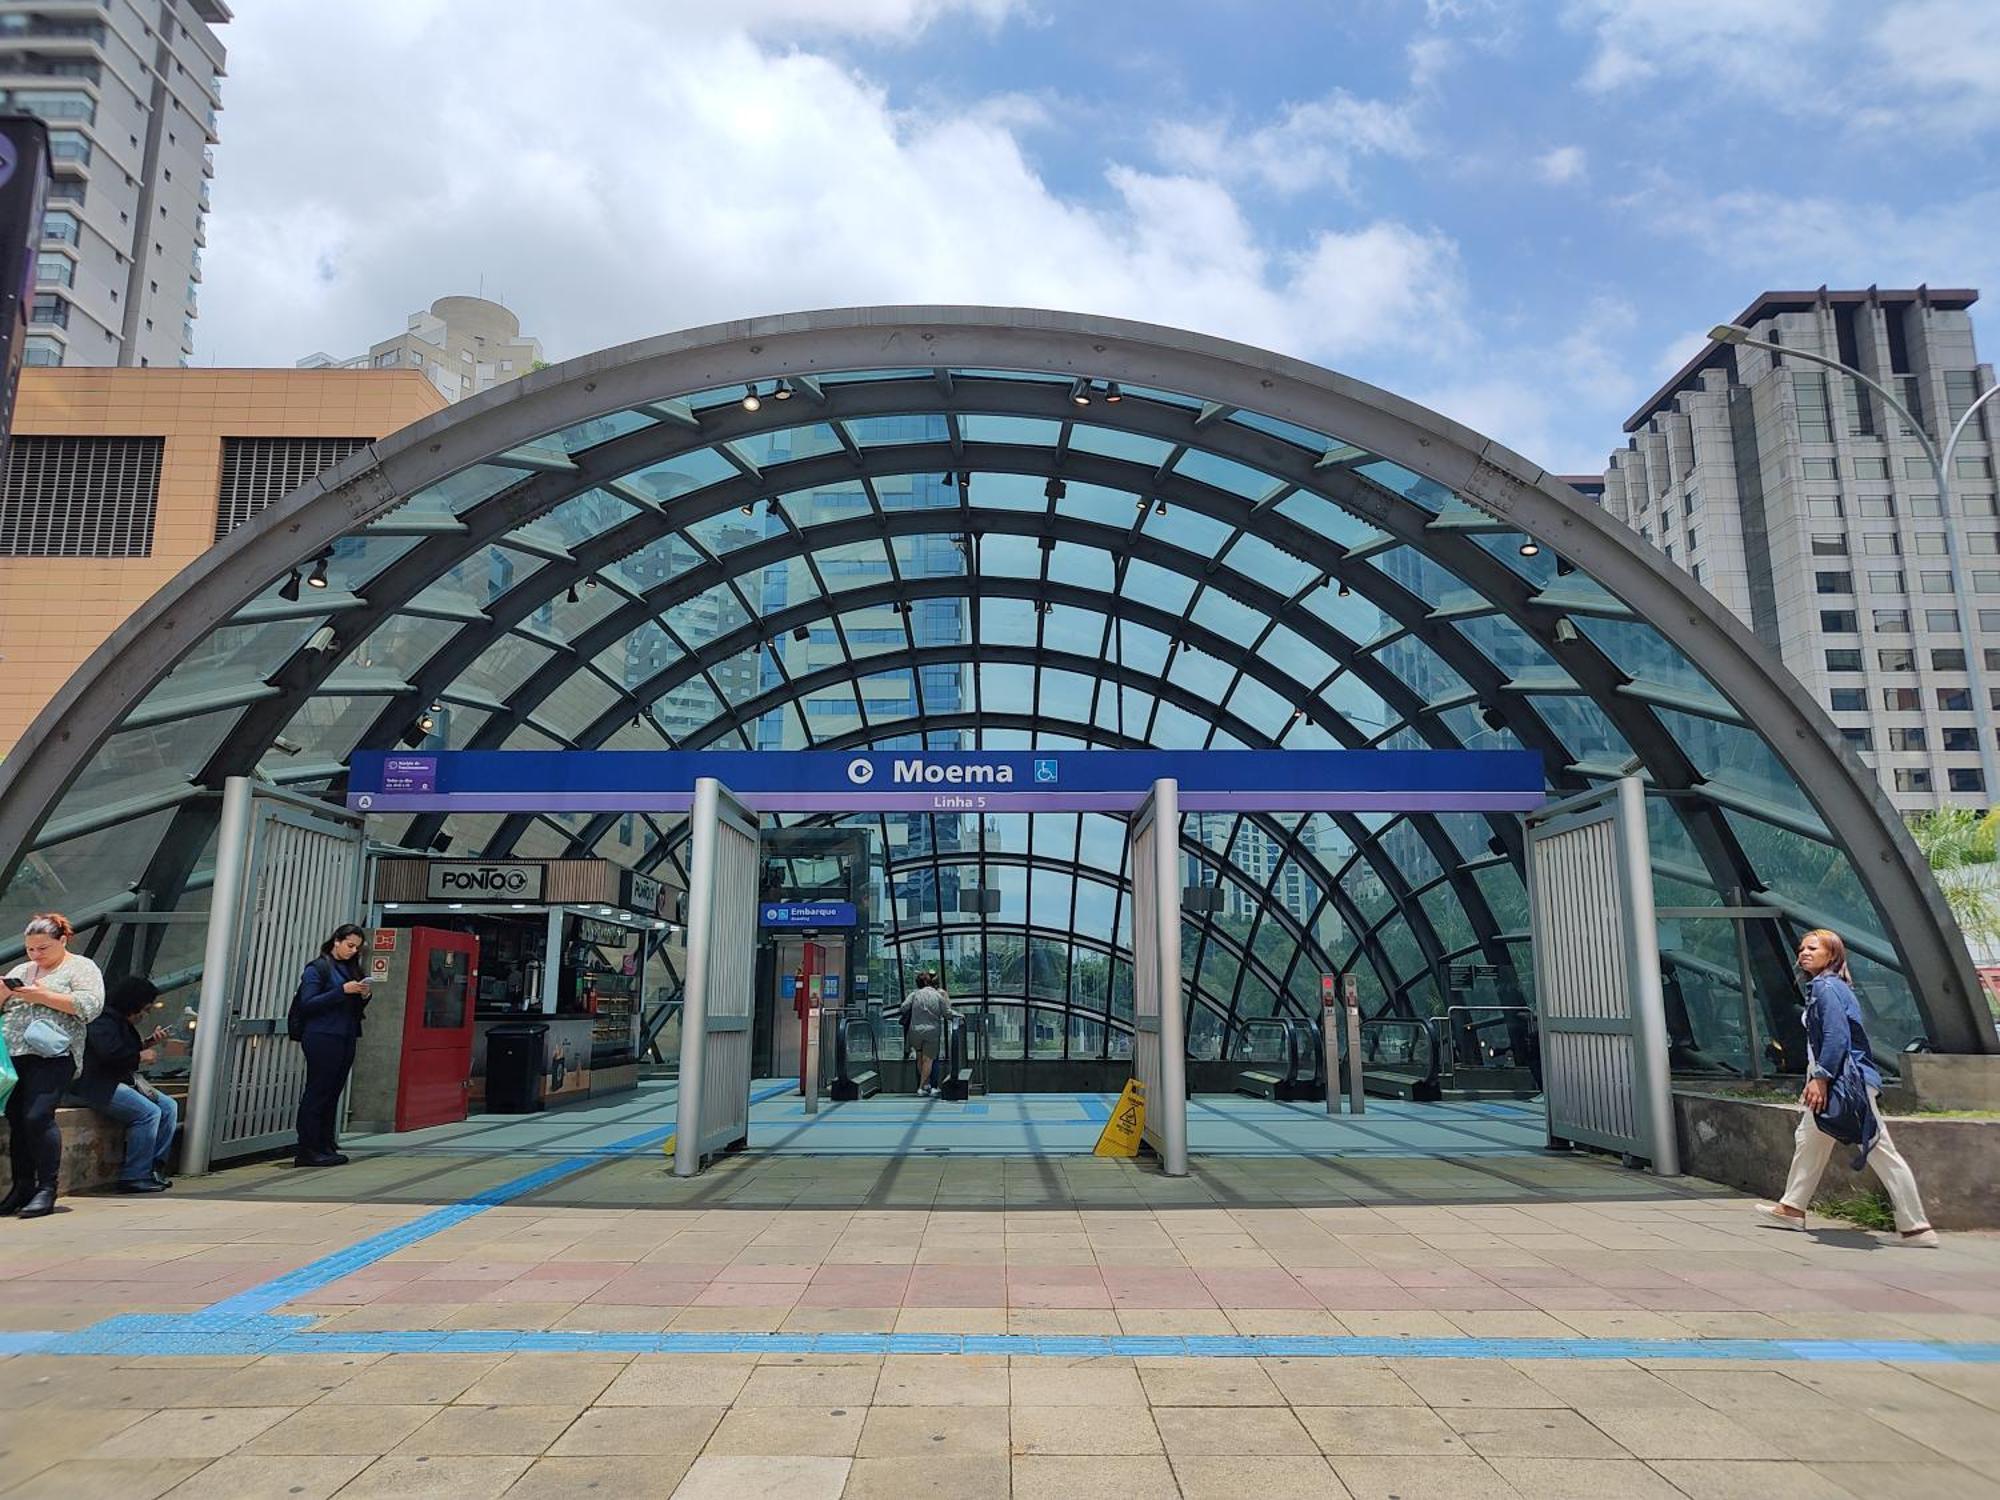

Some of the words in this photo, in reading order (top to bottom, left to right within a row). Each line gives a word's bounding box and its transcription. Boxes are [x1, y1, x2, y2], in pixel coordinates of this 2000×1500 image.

[893, 759, 1013, 783] Moema
[933, 796, 973, 808] Linha
[977, 796, 986, 808] 5
[791, 907, 837, 916] Embarque
